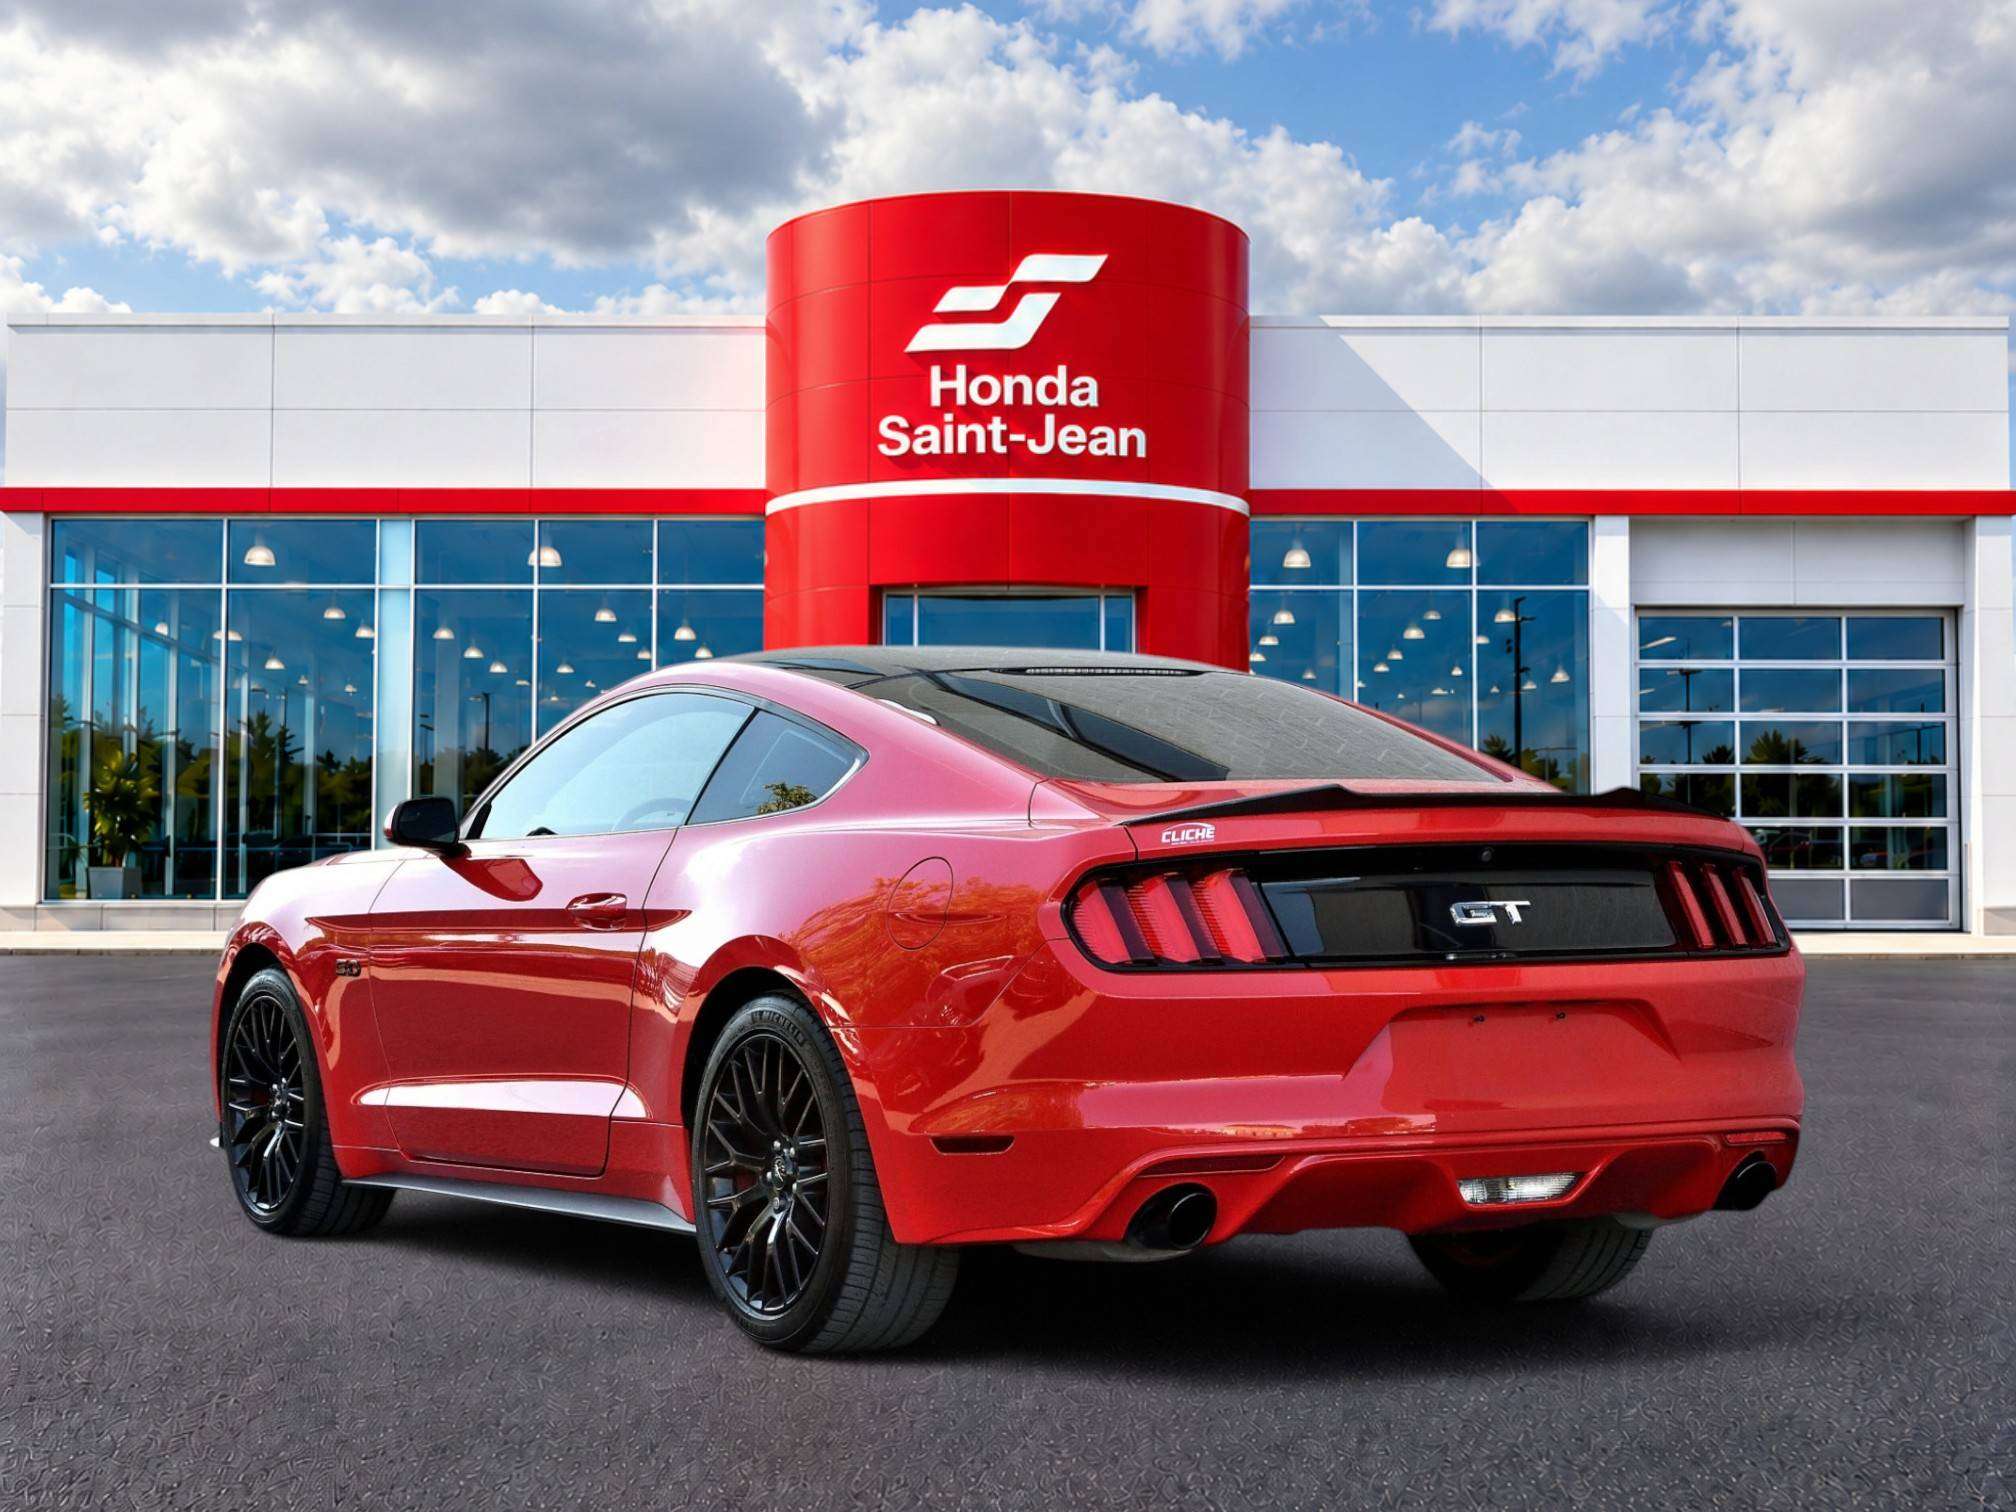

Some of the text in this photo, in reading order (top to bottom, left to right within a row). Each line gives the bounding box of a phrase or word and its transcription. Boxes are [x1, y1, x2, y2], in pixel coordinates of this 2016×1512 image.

[930, 365, 1099, 407] Honda
[877, 413, 1147, 457] Saint-Jean
[1450, 900, 1531, 926] GT
